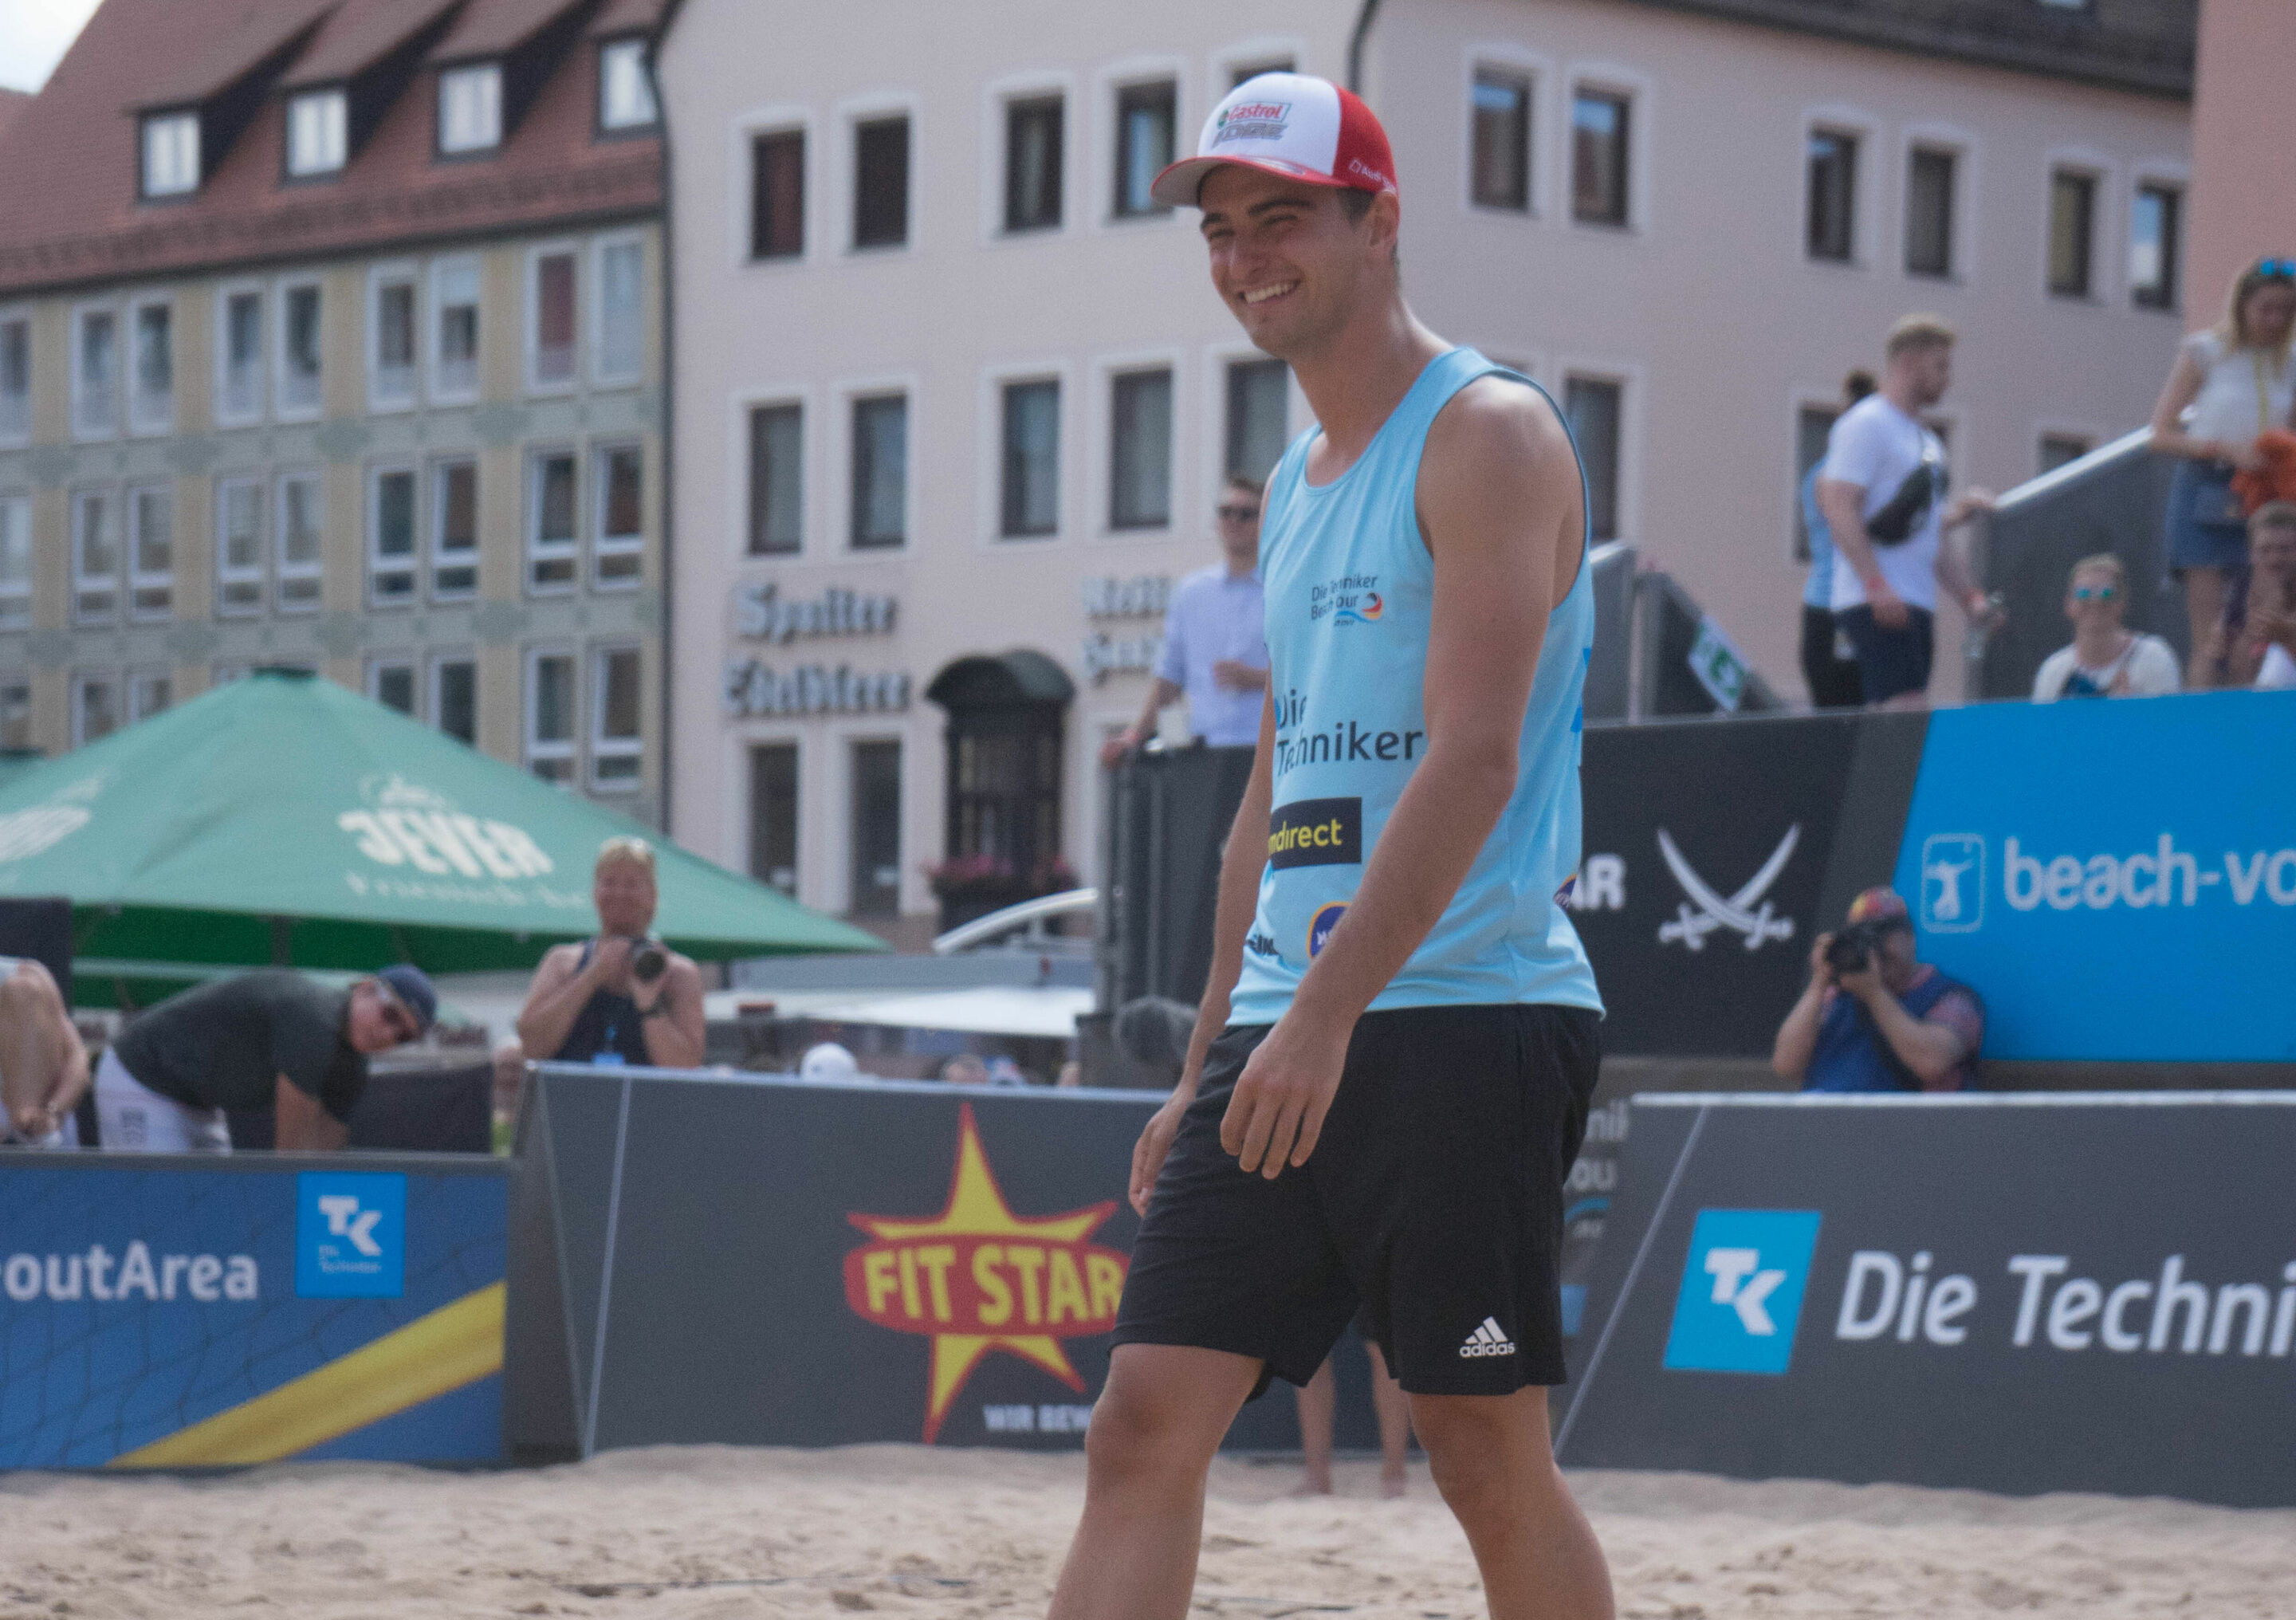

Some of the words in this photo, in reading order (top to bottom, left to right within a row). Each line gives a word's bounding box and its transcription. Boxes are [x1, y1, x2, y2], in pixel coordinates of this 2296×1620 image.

[1229, 103, 1283, 120] Castrol
[1277, 720, 1424, 777] Tehniker
[318, 1194, 383, 1256] TK
[4, 1240, 259, 1301] outArea
[863, 1244, 955, 1324] FIT
[971, 1243, 1124, 1327] STAR
[1703, 1247, 1787, 1337] TK
[1835, 1249, 1978, 1345] Die
[2007, 1253, 2296, 1357] Techni
[1460, 1342, 1516, 1359] adidas
